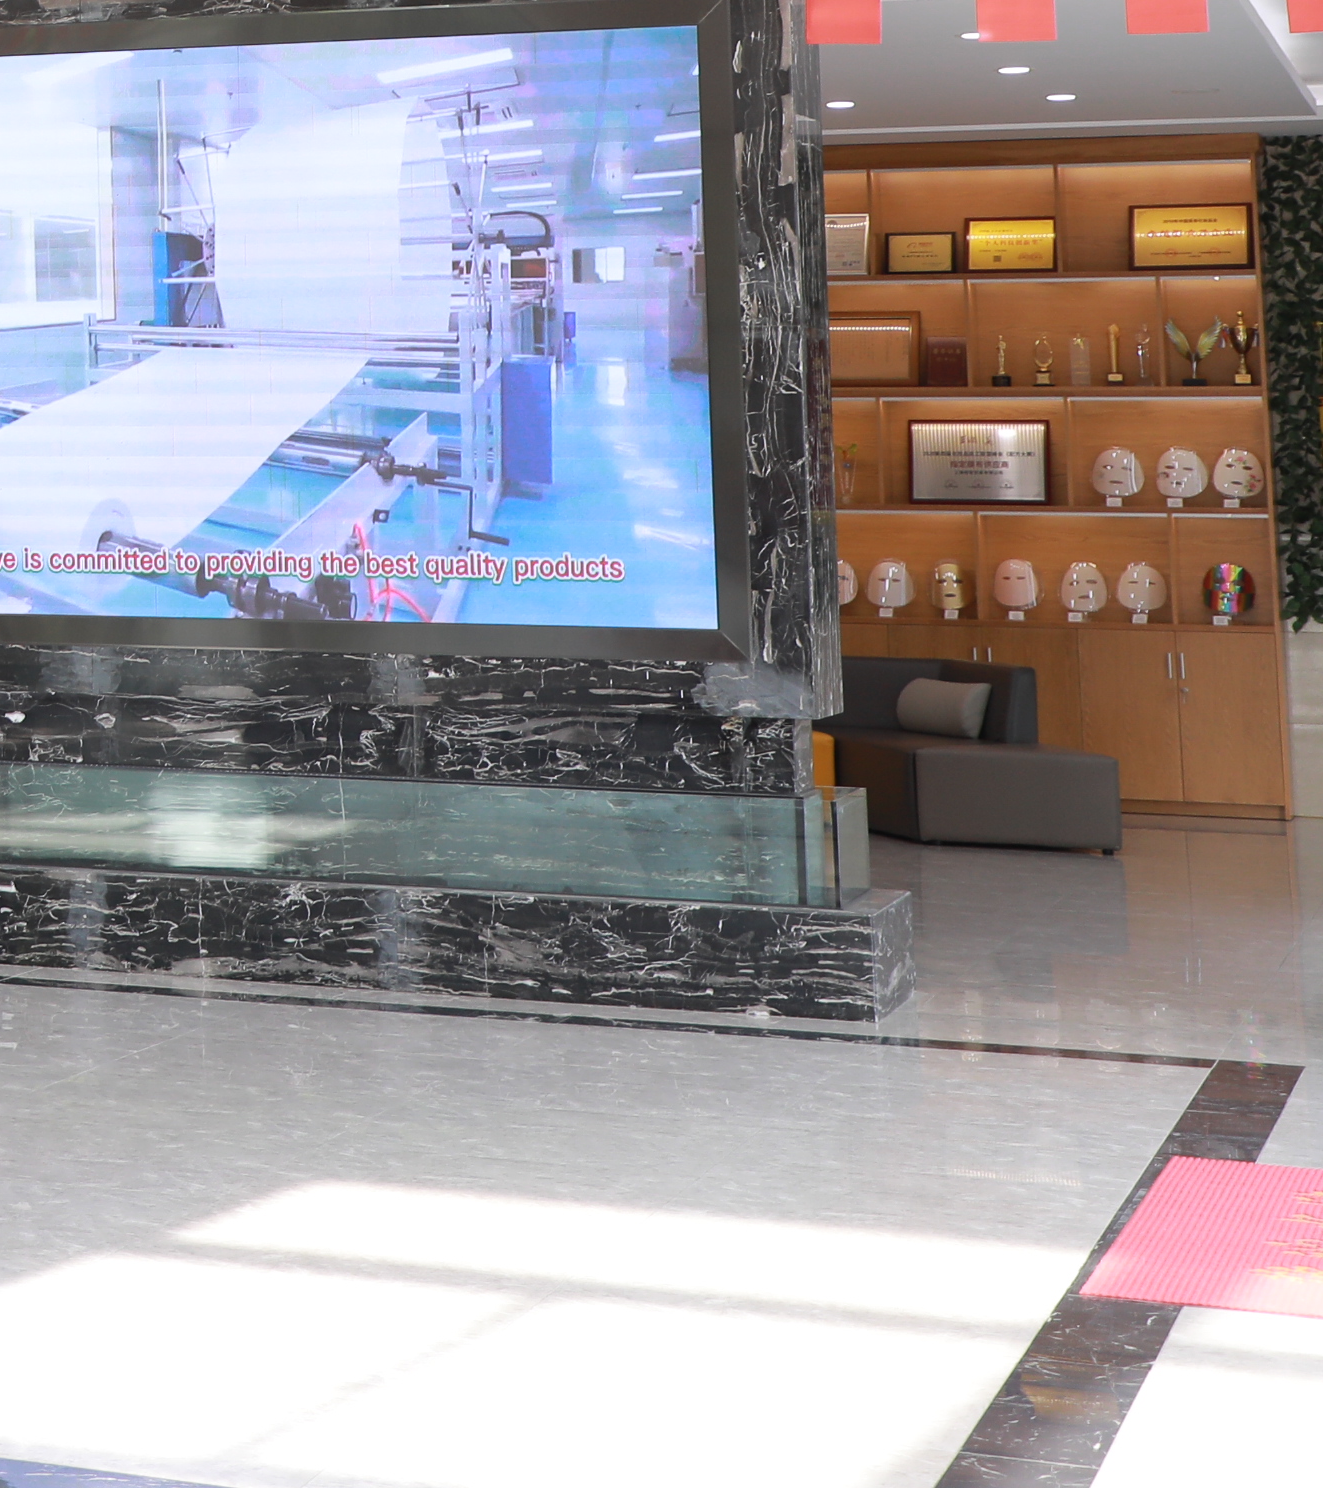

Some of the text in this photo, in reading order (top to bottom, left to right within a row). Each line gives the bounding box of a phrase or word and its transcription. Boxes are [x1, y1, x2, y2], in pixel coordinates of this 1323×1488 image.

[24, 547, 42, 570] is
[52, 547, 168, 572] committed
[175, 549, 199, 572] to
[206, 549, 313, 580] providing
[320, 551, 357, 574] the
[365, 551, 419, 575] best
[424, 552, 507, 583] quality
[514, 554, 625, 585] products
